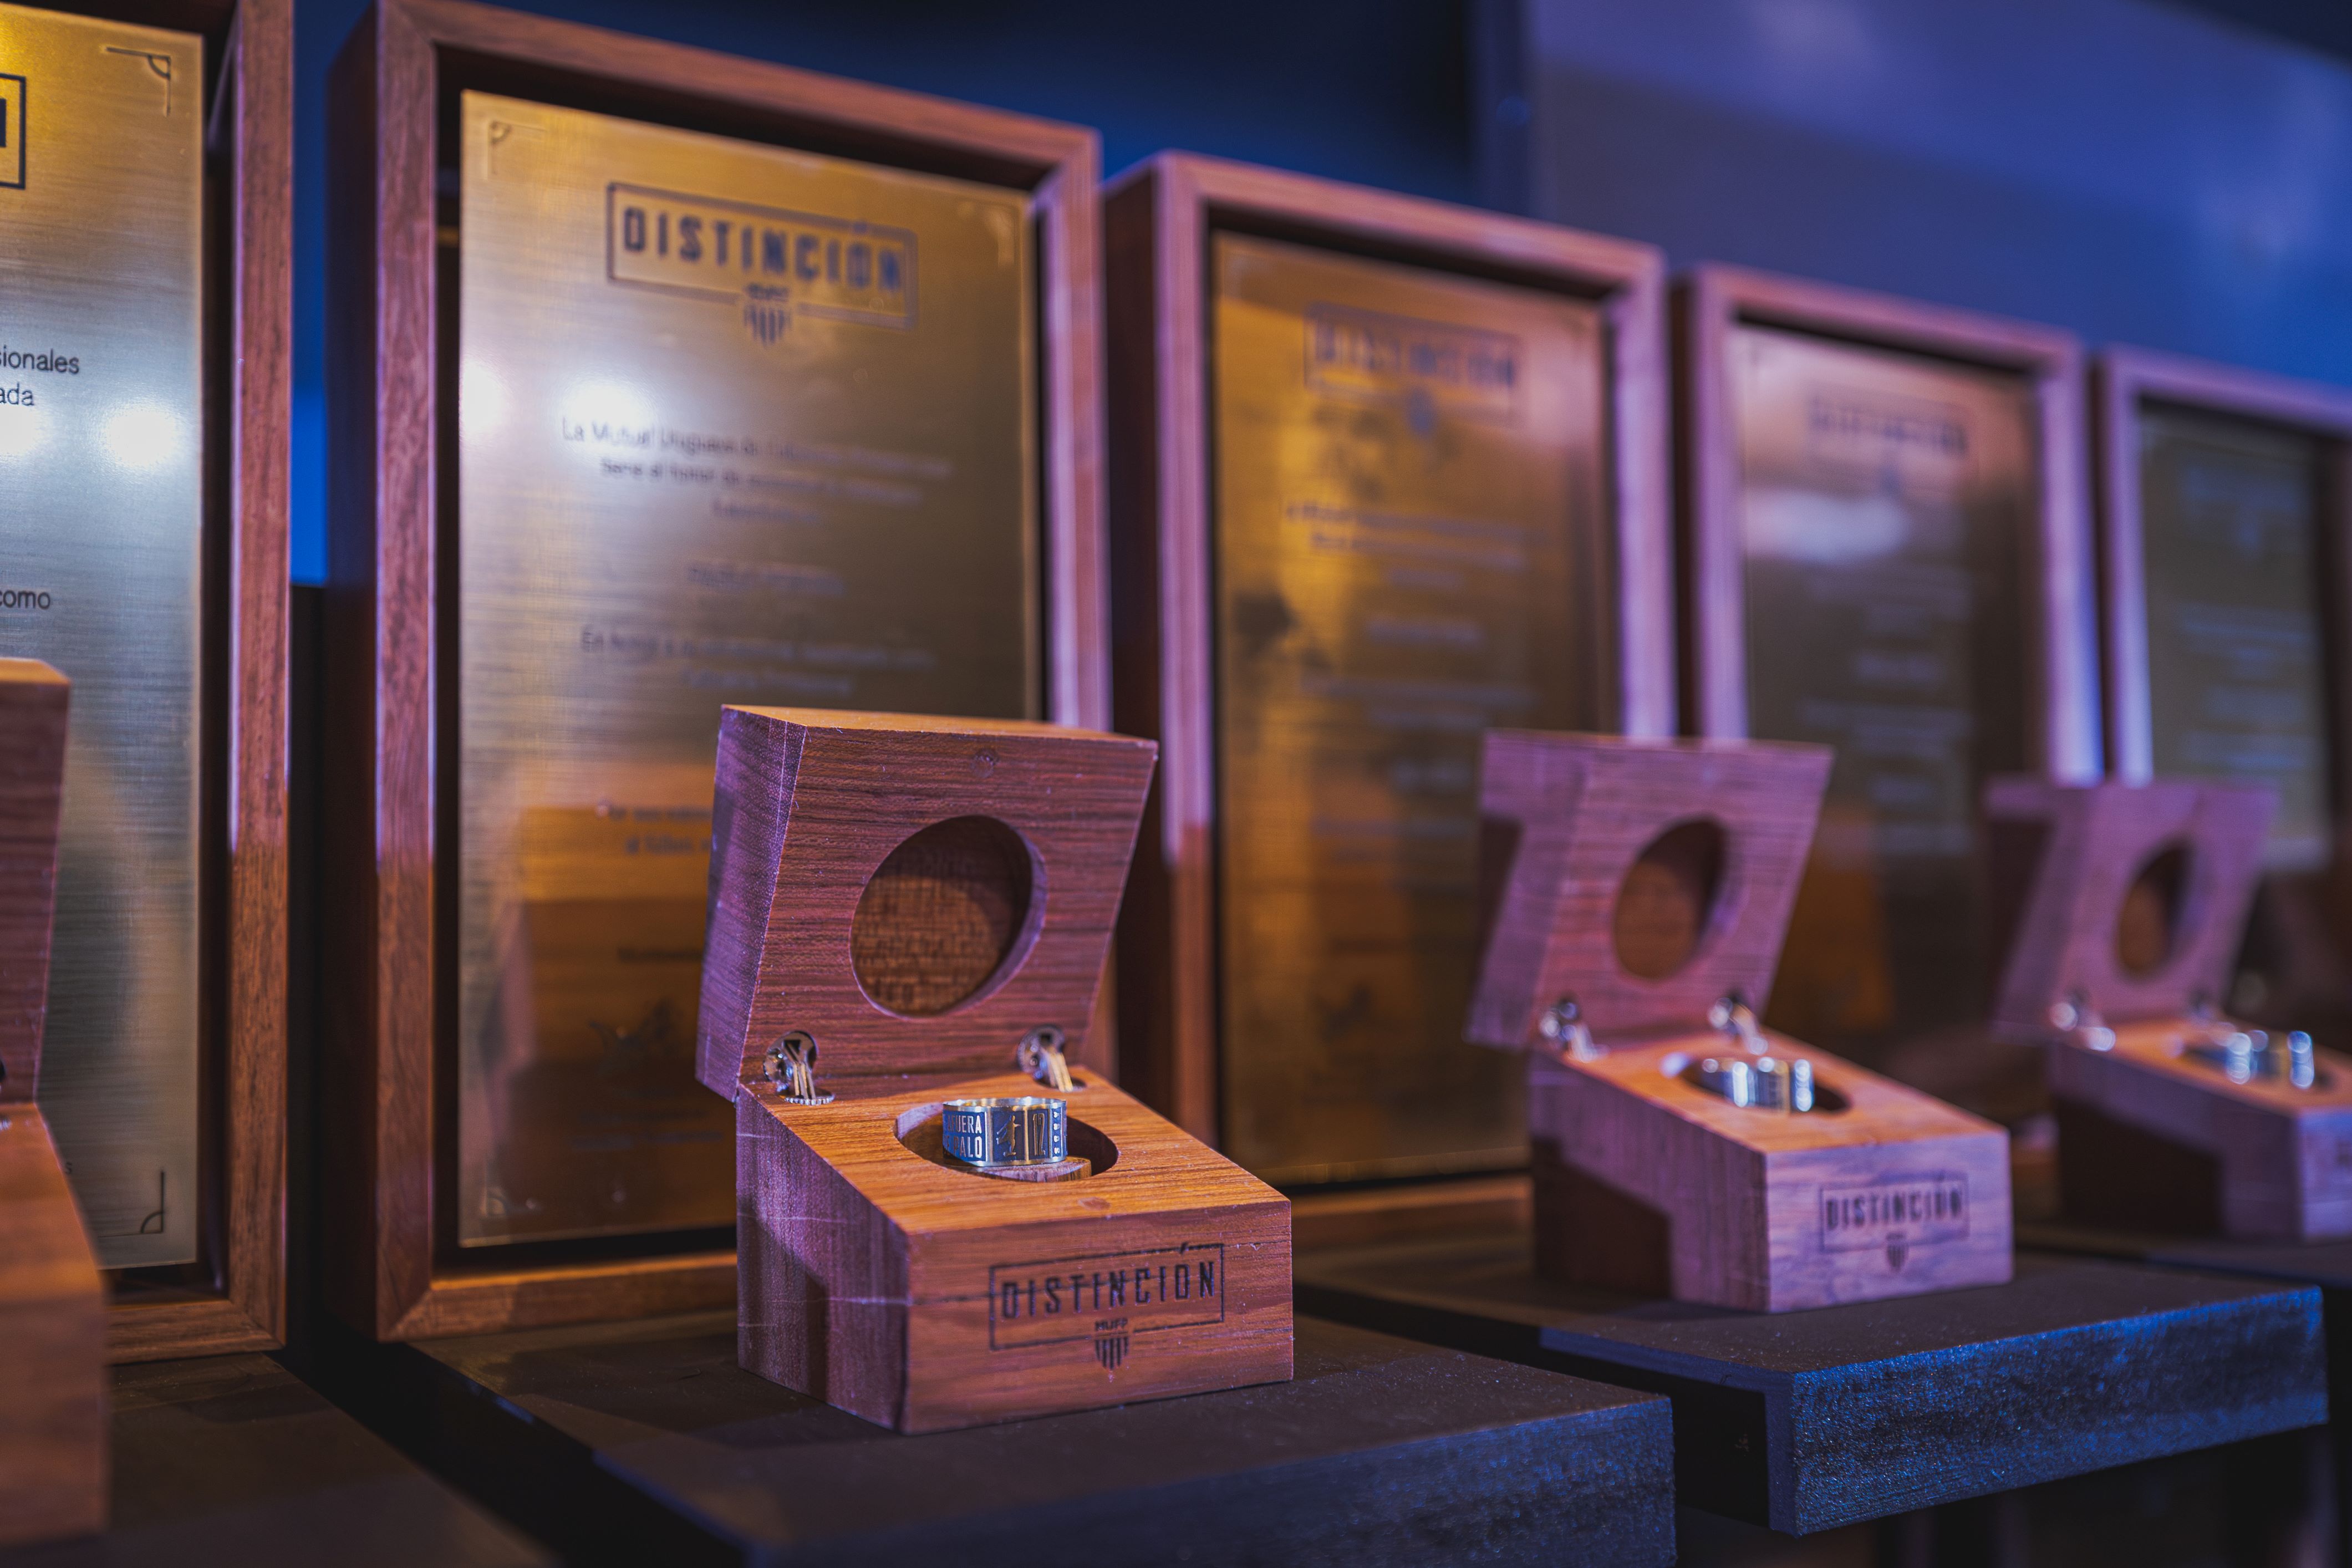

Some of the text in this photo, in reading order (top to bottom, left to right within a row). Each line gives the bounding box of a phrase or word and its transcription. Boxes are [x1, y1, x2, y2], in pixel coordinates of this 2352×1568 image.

[0, 344, 79, 375] ionales
[0, 589, 51, 610] omo
[948, 1114, 982, 1134] AFUERA
[953, 1136, 982, 1159] PALO
[1001, 1242, 1215, 1318] DISTINCIÓN
